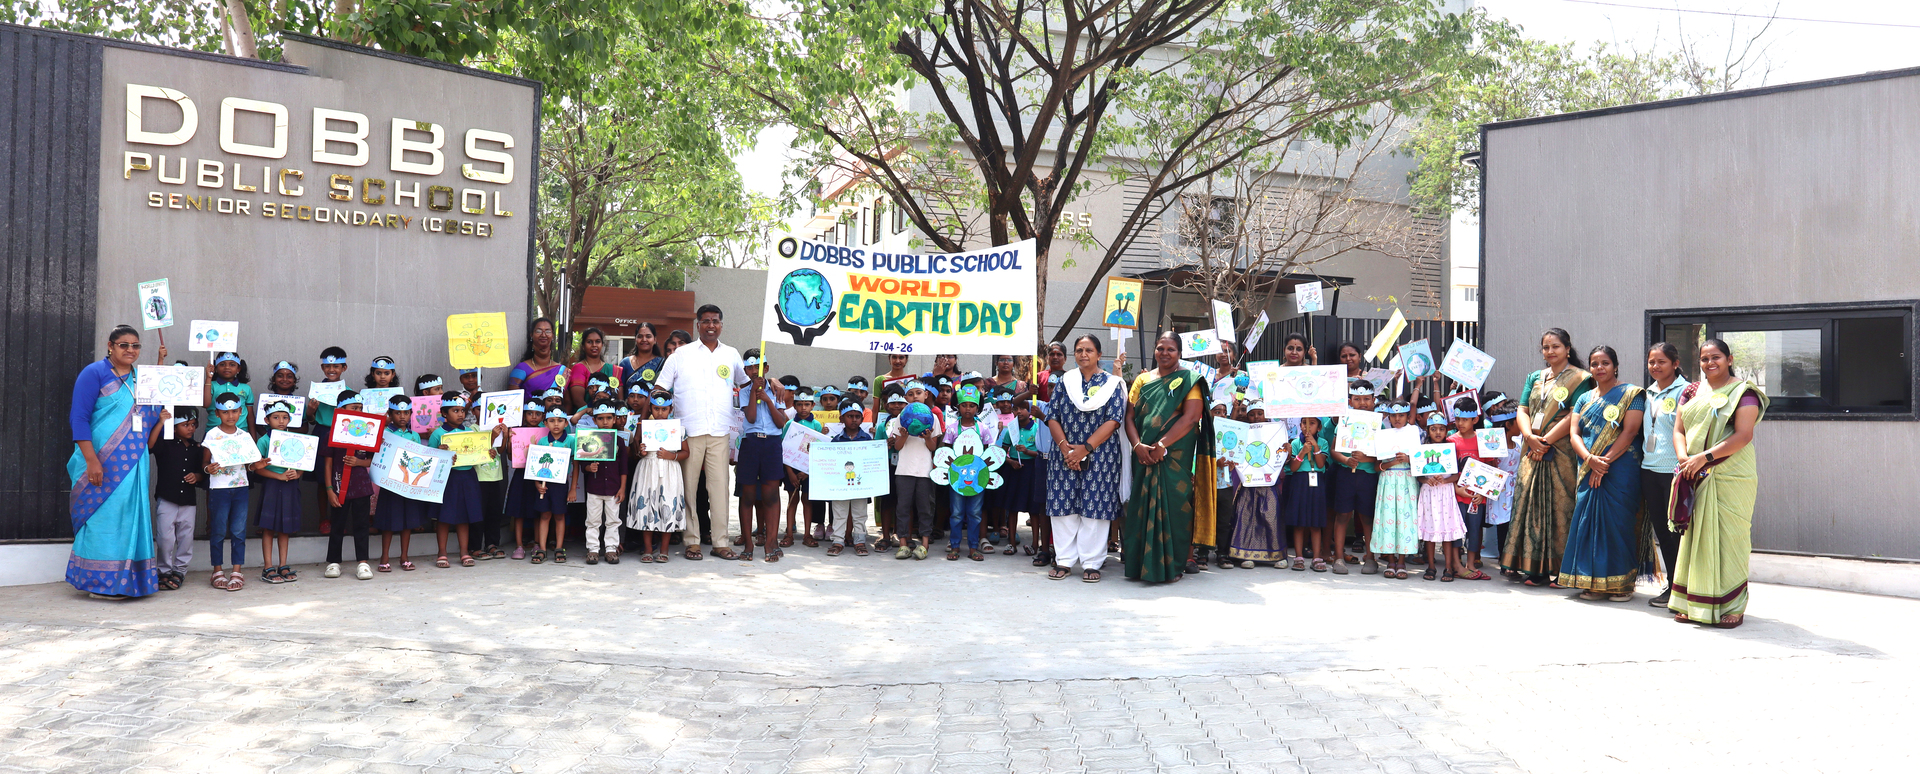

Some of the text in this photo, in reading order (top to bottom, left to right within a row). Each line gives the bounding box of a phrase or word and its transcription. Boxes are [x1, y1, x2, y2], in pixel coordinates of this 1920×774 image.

[126, 83, 515, 185] DOBBS
[124, 150, 513, 217] PUBLIC SCHOOL
[148, 191, 495, 239] SENIOR SECONDARY (CBSE)
[800, 241, 1022, 274] DOBBS PUBLIC SCHOOL
[849, 275, 961, 297] WORLD
[838, 294, 1022, 336] EARTH DAY
[869, 341, 913, 352] 17-04-26
[404, 441, 420, 452] SAVE
[423, 489, 440, 498] HOME
